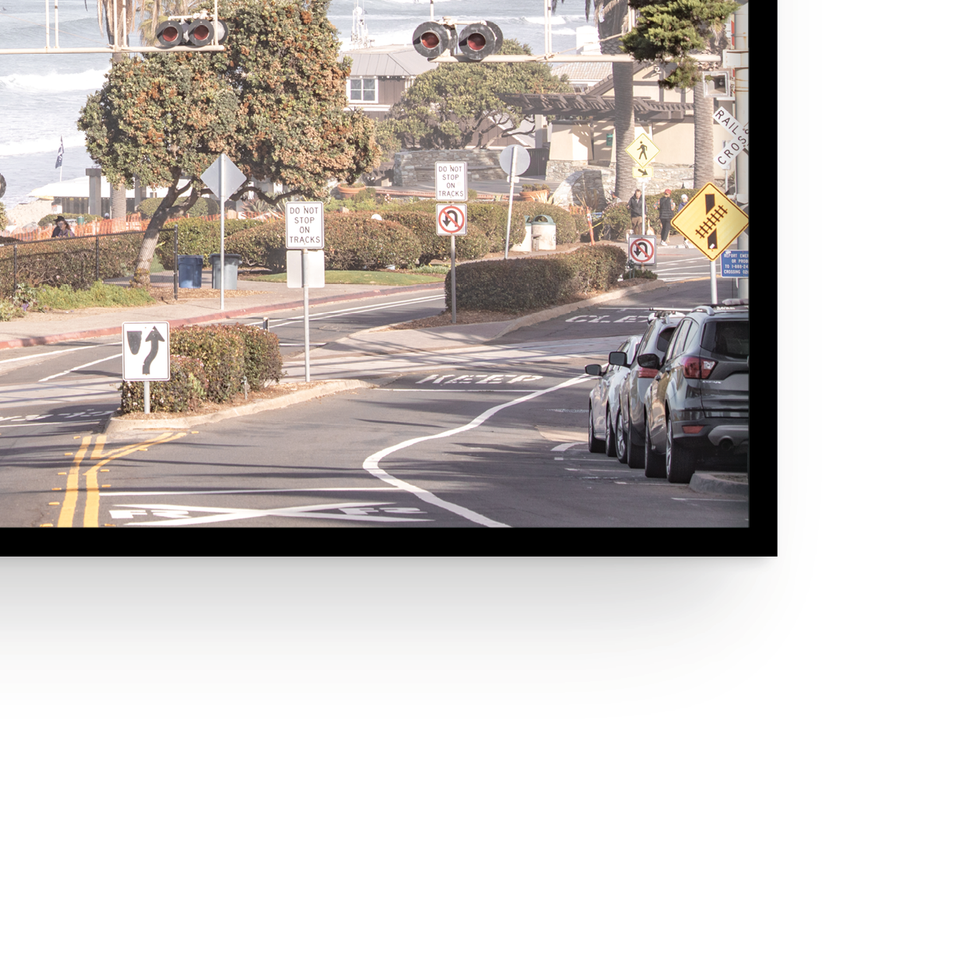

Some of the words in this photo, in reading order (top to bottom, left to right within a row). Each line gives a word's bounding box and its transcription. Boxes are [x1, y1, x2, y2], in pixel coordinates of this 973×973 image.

[715, 109, 739, 135] RAIL
[303, 206, 318, 214] NOT
[299, 226, 310, 234] ON
[289, 235, 320, 243] TRACKS
